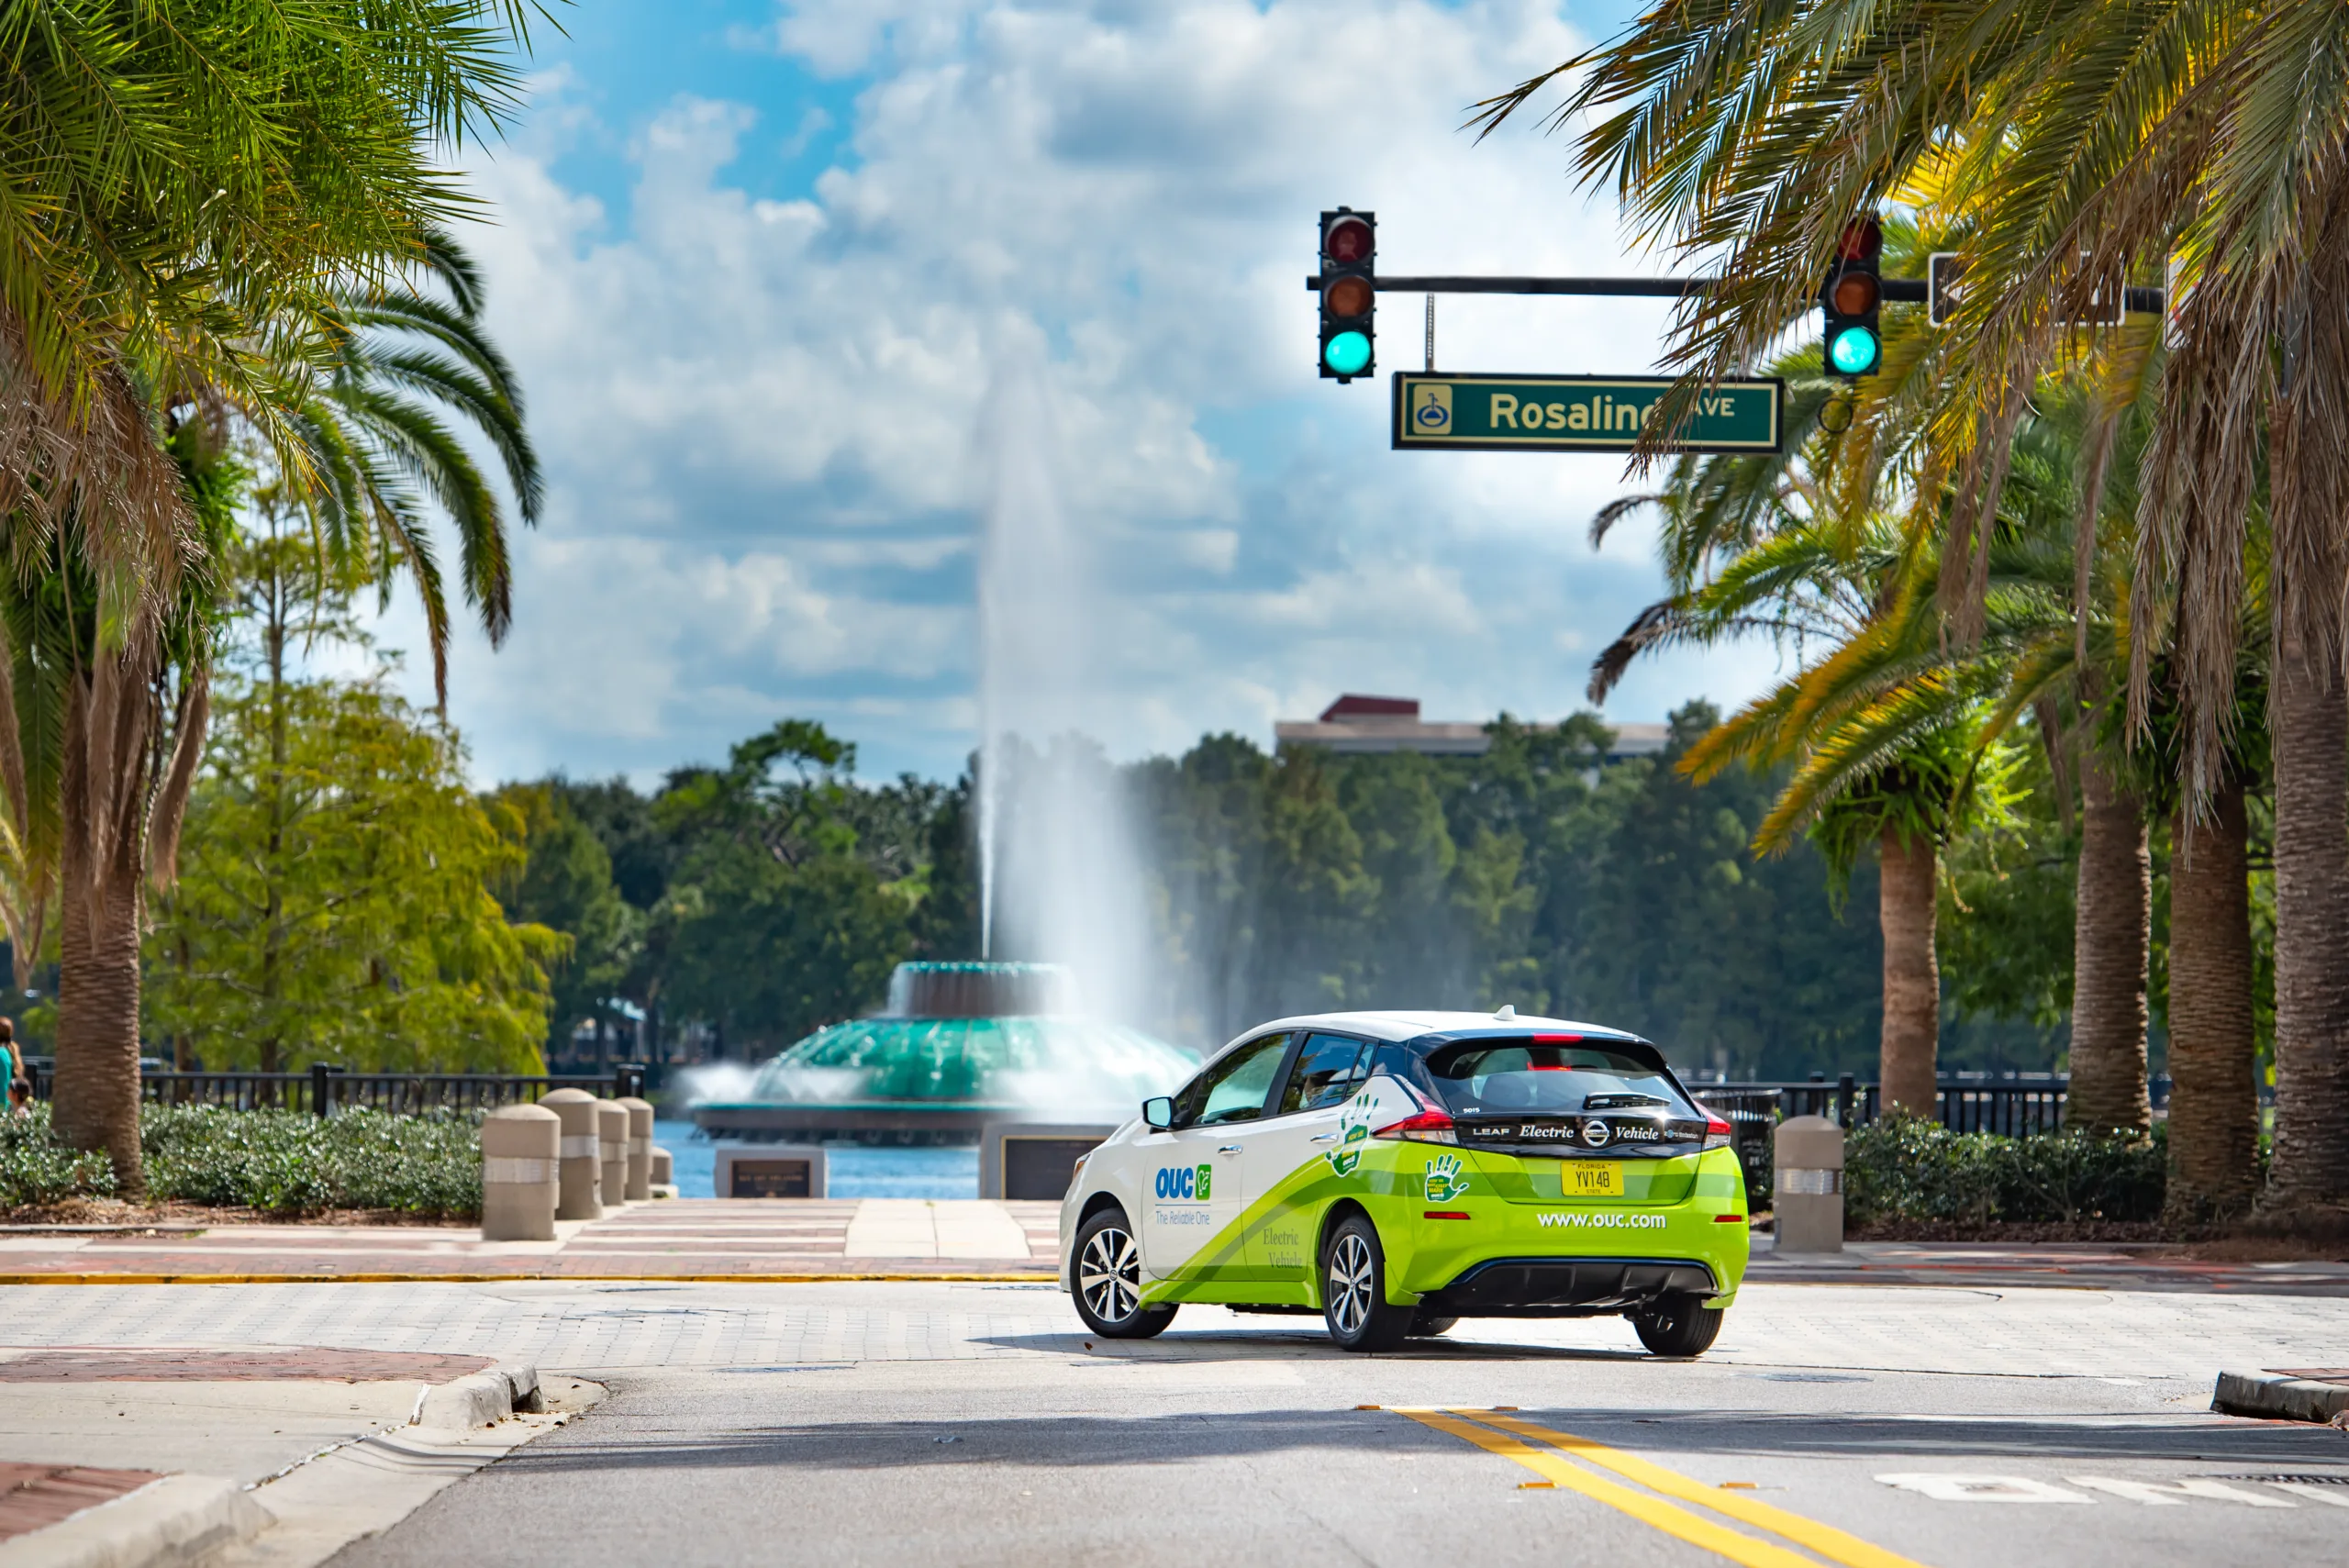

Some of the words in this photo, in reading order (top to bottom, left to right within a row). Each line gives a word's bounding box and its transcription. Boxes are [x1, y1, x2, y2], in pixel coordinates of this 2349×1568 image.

[1520, 1125, 1575, 1139] Electric
[1615, 1126, 1659, 1140] Vehicle
[1155, 1167, 1194, 1199] OUC
[1156, 1210, 1168, 1225] The
[1170, 1210, 1195, 1225] Reliable
[1196, 1210, 1210, 1225] One
[1537, 1213, 1667, 1229] www.ouc.com
[1263, 1228, 1299, 1245] Electric
[1268, 1251, 1303, 1269] Vehicle
